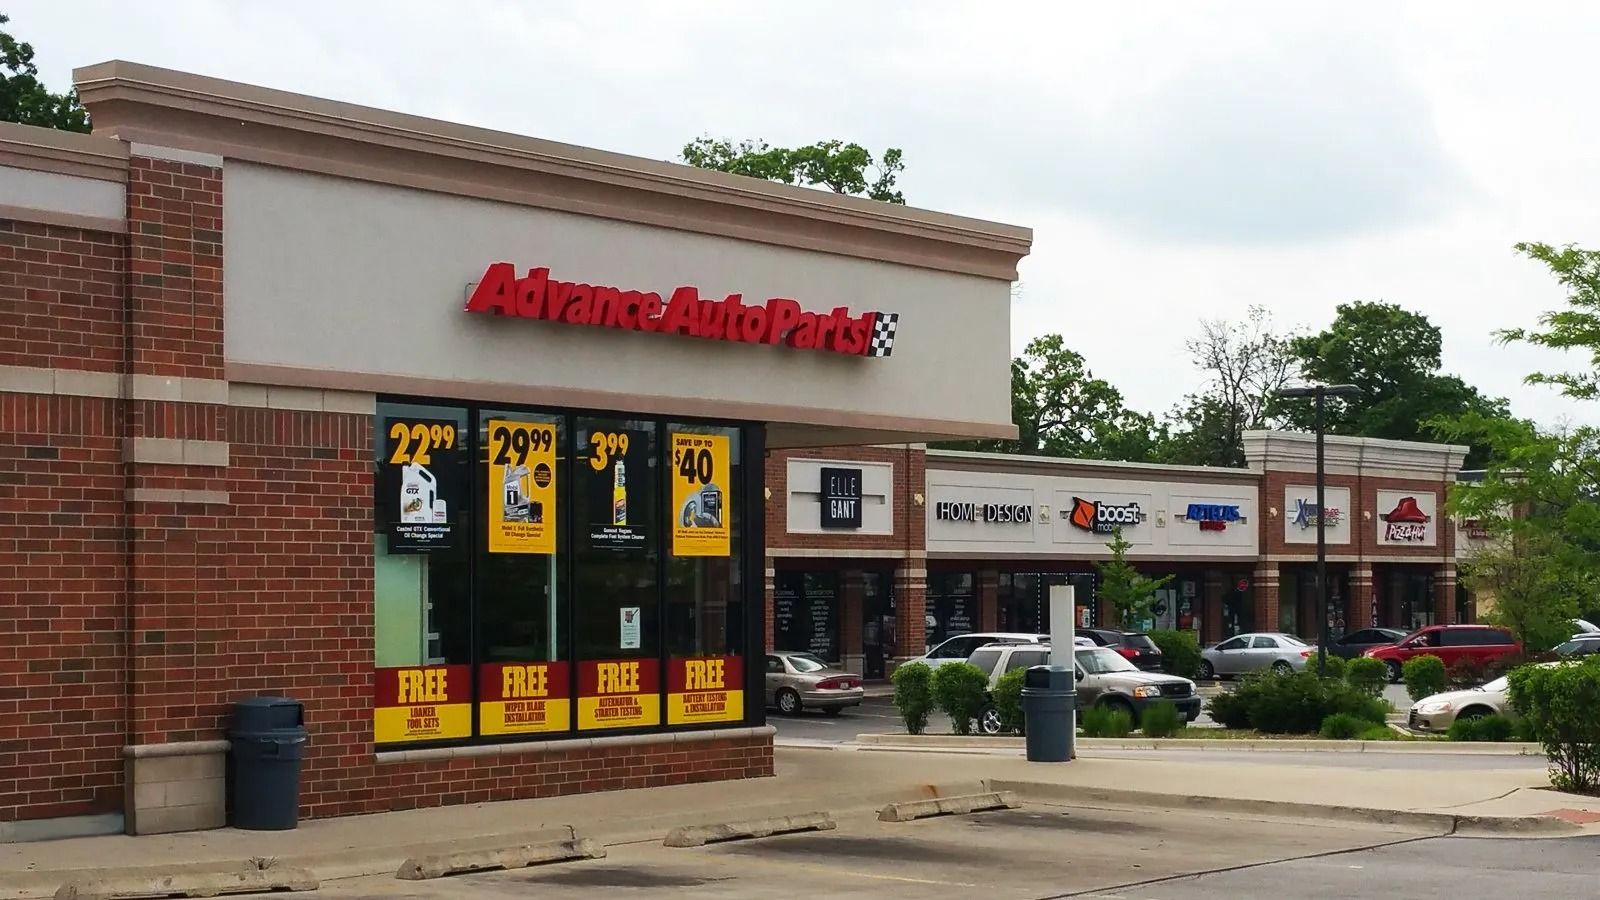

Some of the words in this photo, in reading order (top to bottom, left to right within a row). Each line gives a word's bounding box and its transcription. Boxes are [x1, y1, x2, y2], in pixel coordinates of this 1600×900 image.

[464, 262, 662, 331] Advance
[658, 286, 767, 344] Auto
[766, 298, 870, 356] Parts
[675, 438, 692, 448] SAVE
[693, 439, 703, 448] UP
[704, 440, 713, 448] TO
[674, 447, 714, 485] $40
[830, 476, 856, 496] ELLE
[831, 500, 856, 519] GANT
[936, 501, 981, 522] HOME
[983, 503, 1032, 523] DESIGN
[1097, 502, 1140, 523] boost
[1386, 523, 1411, 541] Pizza
[1411, 524, 1426, 541] Hut
[502, 665, 549, 698] FREE
[596, 661, 640, 694] FREE
[685, 659, 725, 690] FREE
[397, 668, 448, 704] FREE
[504, 702, 525, 712] WIPER
[526, 701, 546, 711] BLADE
[598, 696, 633, 708] ALTERNATOR
[683, 694, 705, 703] BATTERY
[706, 692, 728, 702] TESTING
[410, 706, 436, 718] LOANER
[594, 707, 619, 718] STARTER
[620, 706, 642, 716] TESTING
[690, 702, 726, 713] INSTALLATION
[406, 718, 422, 729] TOOL
[423, 717, 440, 728] SETS
[504, 712, 546, 723] INSTALLATION
